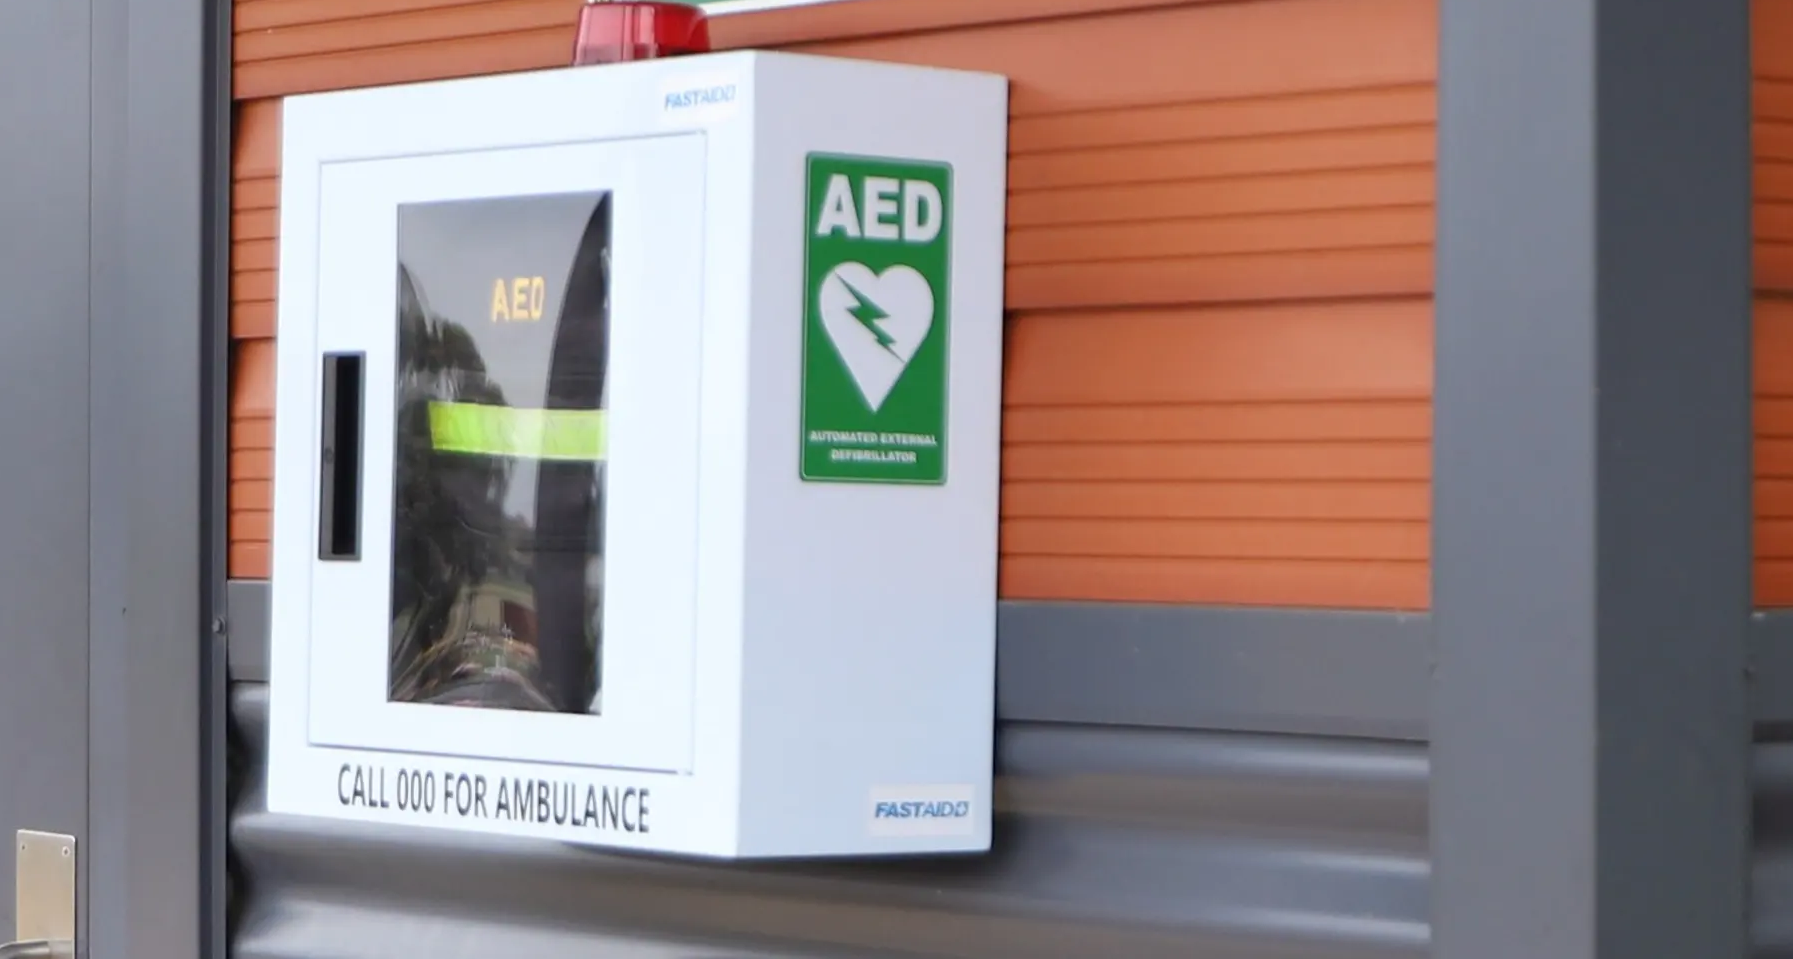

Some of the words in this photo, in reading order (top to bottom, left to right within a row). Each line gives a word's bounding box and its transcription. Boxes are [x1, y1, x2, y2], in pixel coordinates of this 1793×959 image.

[816, 174, 943, 242] AED
[491, 276, 545, 323] AED
[809, 430, 877, 444] AUTOMATED
[880, 432, 937, 446] EXTERNAL
[830, 448, 917, 463] DEFIBRILLATOR
[338, 763, 389, 808] CALL
[397, 768, 436, 814] 000
[444, 773, 488, 818] FOR
[495, 776, 650, 833] AMBULANCE
